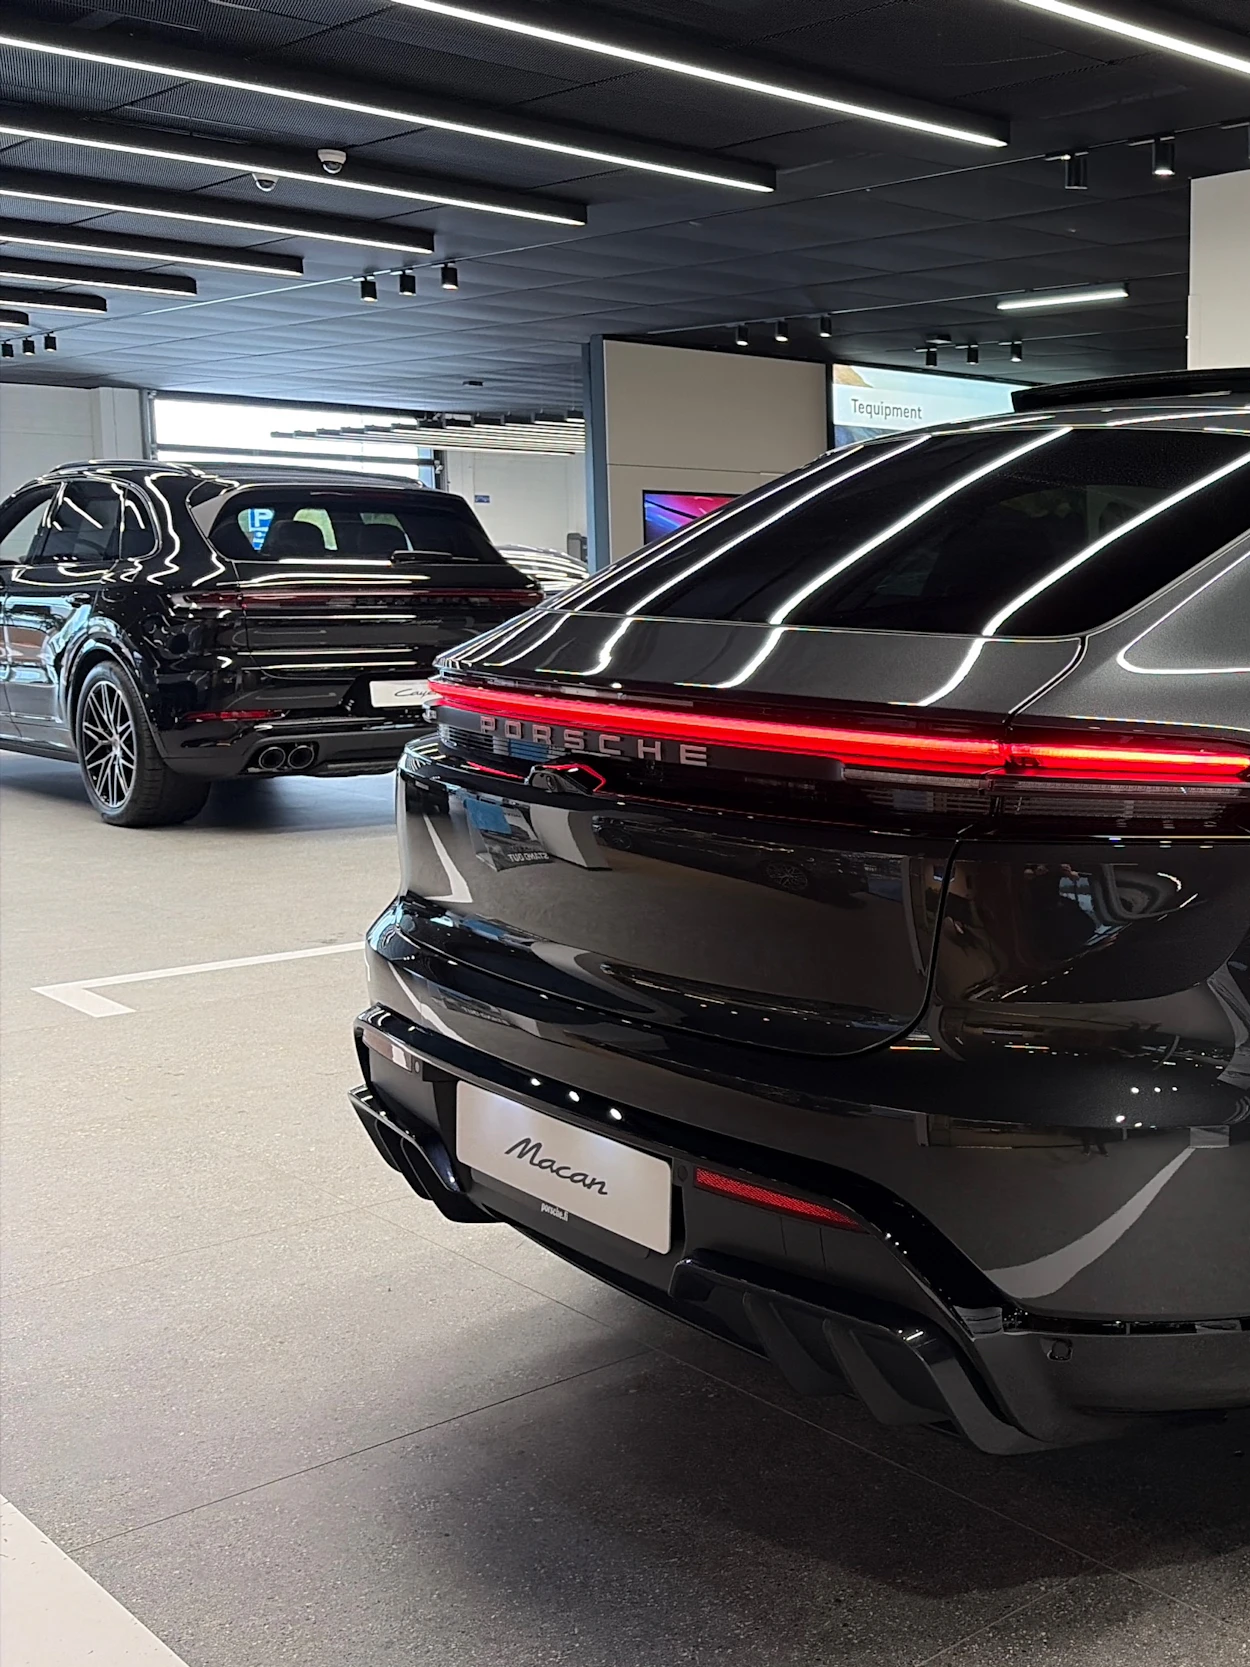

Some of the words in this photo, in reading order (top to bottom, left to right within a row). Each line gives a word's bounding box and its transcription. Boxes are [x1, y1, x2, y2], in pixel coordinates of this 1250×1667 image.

[851, 398, 922, 420] Tequipment
[394, 688, 437, 698] Caye
[480, 715, 707, 767] PORSCHE
[504, 1137, 608, 1195] Macan
[540, 1202, 569, 1221] porsche.fi
